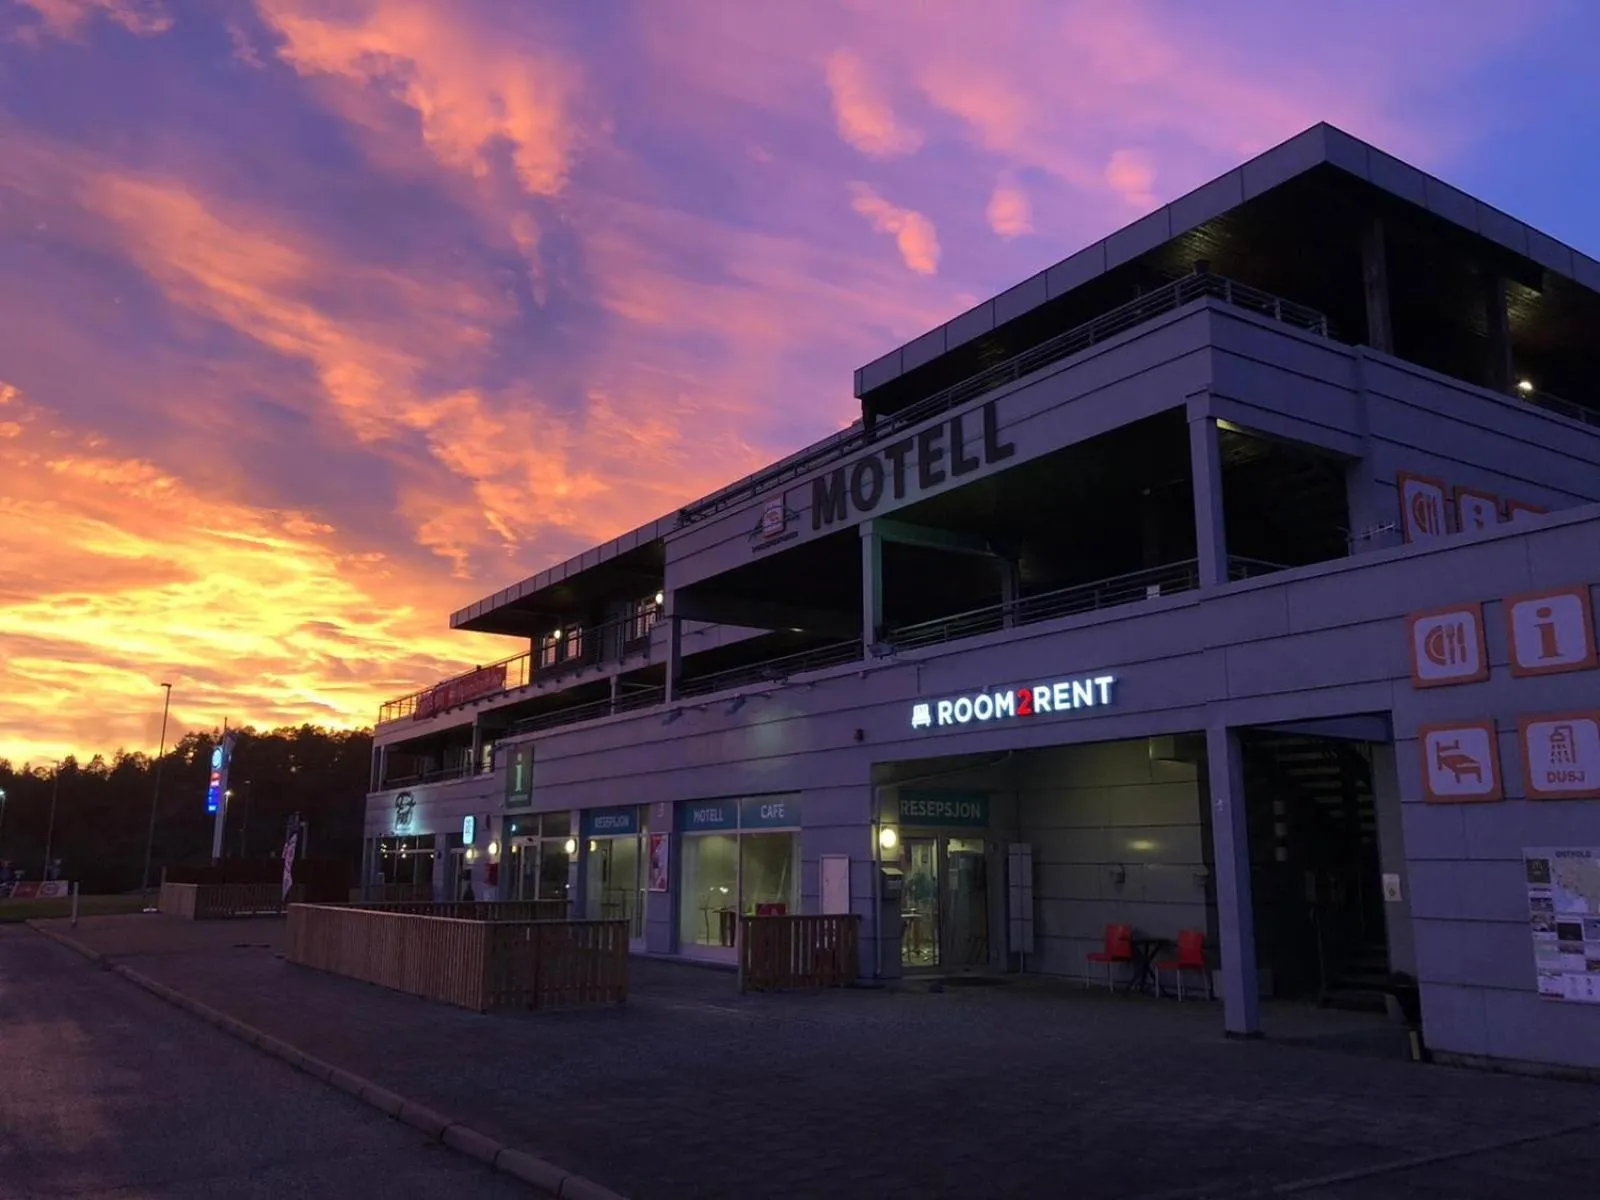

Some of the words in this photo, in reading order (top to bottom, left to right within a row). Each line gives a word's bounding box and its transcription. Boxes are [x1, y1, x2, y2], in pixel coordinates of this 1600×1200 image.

[812, 401, 1015, 530] MOTELL
[937, 675, 1114, 726] ROOM2RENT
[1546, 770, 1586, 784] DUSJ
[693, 807, 724, 825] MOTELL
[899, 799, 982, 819] RESEPSJON
